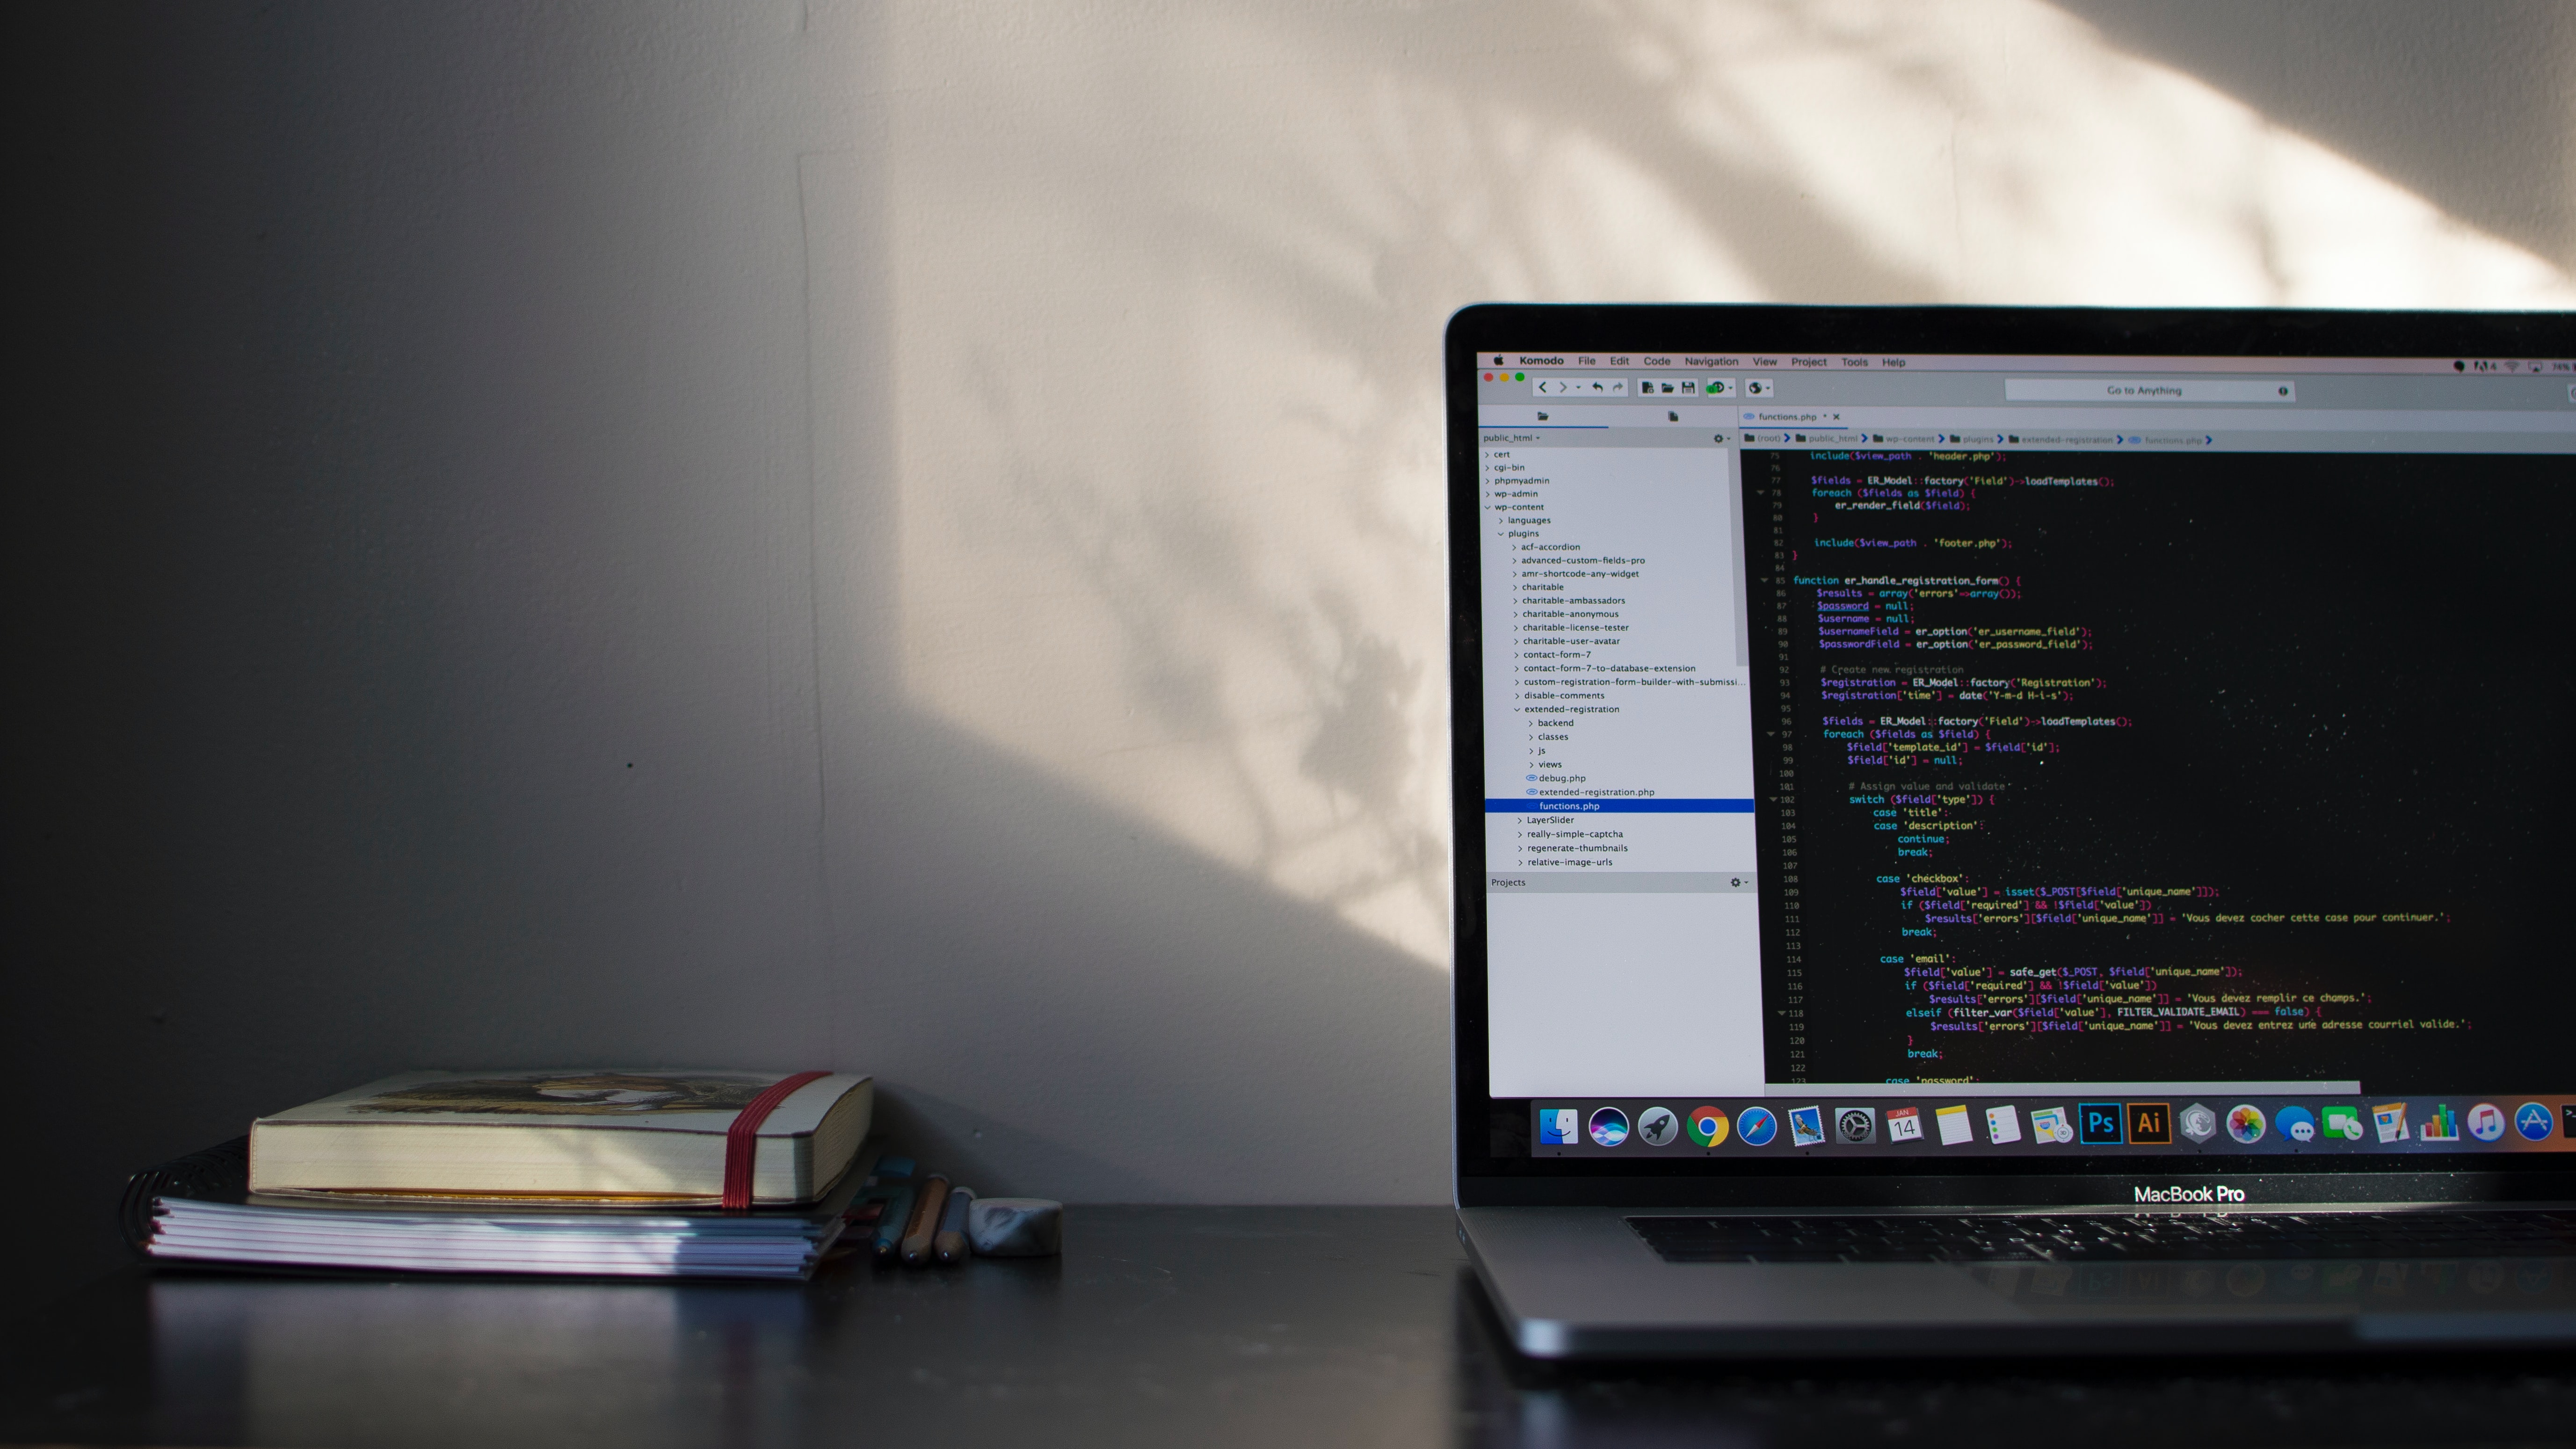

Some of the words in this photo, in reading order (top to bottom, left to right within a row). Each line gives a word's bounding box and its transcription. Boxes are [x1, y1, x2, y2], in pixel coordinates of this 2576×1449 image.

[1520, 356, 1564, 365] Komodo
[1578, 356, 1596, 365] File
[1610, 356, 1629, 366] Edit
[1644, 356, 1671, 366] Code
[1685, 357, 1739, 368] Navigation
[1753, 357, 1778, 366] View
[1792, 357, 1827, 368] Project
[1842, 358, 1868, 367] Tools
[1882, 358, 1906, 368] Help
[2138, 387, 2182, 396] Anything
[1759, 413, 1817, 422] functions.php
[1484, 434, 1532, 443] public_html
[1809, 435, 1858, 443] public_html
[1963, 436, 1994, 445] plugins
[2022, 436, 2114, 445] extended-registration
[2145, 437, 2203, 445] functions.php
[1810, 451, 1912, 462] include($view_path
[1929, 451, 2006, 462] 'header.php');
[1494, 464, 1525, 473] cgi-bin
[1495, 477, 1550, 485] phpmyadmin
[1811, 476, 1851, 485] $fields
[1494, 490, 1538, 499] wp-admin
[1812, 487, 1852, 498] foreach
[1857, 488, 1903, 498] ($fields
[1924, 488, 1965, 499] $field)
[1508, 516, 1551, 526] languages
[1509, 529, 1539, 539] plugins
[1521, 543, 1581, 551] acf-accordion
[1814, 538, 1917, 549] include($view_path
[1934, 538, 2012, 549] 'footer.php');
[1521, 556, 1646, 565] advanced-custom-fields-pro
[1522, 570, 1640, 579] amr-shortcode-any-widget
[1793, 575, 1840, 585] function
[1522, 583, 1564, 591] charitable
[1816, 588, 1863, 598] $results
[1817, 601, 1870, 612] $password
[1886, 601, 1914, 612] null;
[1523, 610, 1619, 619] charitable-anonymous
[1818, 613, 1870, 623] $username
[1886, 614, 1915, 624] null;
[1818, 626, 1899, 637] $usernameField
[1819, 639, 1900, 650] $passwordField
[1524, 650, 1591, 659] contact-form-7
[1831, 665, 1866, 676] Create
[1895, 665, 1964, 676] registration
[1524, 678, 1747, 687] custom-registration-form-builder-with-submissi...
[1821, 677, 1896, 689] $registration
[1959, 690, 2023, 701] date('Y-m-d
[2027, 690, 2073, 701] H-i-s');
[1524, 705, 1619, 715] extended-registration
[1822, 716, 1864, 726] $fields
[1538, 732, 1568, 741] classes
[1823, 729, 1865, 739] foreach
[1870, 729, 1916, 740] ($fields
[1938, 729, 1980, 740] $field)
[1538, 746, 1546, 756] js
[1985, 742, 2060, 753] $field['id'];
[1847, 755, 1917, 766] $field['id']
[1934, 755, 1963, 766] null;
[1539, 774, 1586, 784] debug.php
[1539, 788, 1655, 797] extended-registration.php
[1850, 793, 1885, 804] switch
[1890, 794, 1983, 806] ($field['type'])
[1540, 802, 1600, 811] functions.php
[1873, 809, 1897, 818] case
[1903, 807, 1948, 817] 'title':
[1527, 816, 1575, 826] LayerSlider
[1904, 820, 1983, 832] 'description':
[1527, 830, 1624, 839] really-simple-captcha
[1897, 833, 1950, 845] continue;
[1528, 844, 1628, 854] regenerate-thumbnails
[1898, 847, 1933, 858] break;
[1528, 858, 1613, 868] relative-image-urls
[1492, 878, 1526, 888] Projects
[1907, 873, 1969, 883] 'checkbox':
[1900, 886, 1988, 898] $field['value']
[1901, 900, 1913, 910] if
[2054, 899, 2152, 911] !$field['value'])
[2182, 913, 2211, 922] 'Vous
[2215, 913, 2245, 922] devez
[2250, 913, 2286, 922] cocher
[2290, 913, 2320, 922] cette
[2353, 914, 2377, 923] pour
[2382, 912, 2451, 923] continuer.';
[1902, 927, 1937, 938] break;
[1910, 953, 1956, 964] 'email':
[1904, 965, 1993, 978] $field['value']
[2010, 966, 2104, 978] safe_get($_POST,
[1905, 980, 1917, 990] if
[2059, 980, 2157, 992] !$field['value'])
[2187, 993, 2217, 1003] 'Vous
[2221, 993, 2251, 1003] devez
[2256, 993, 2298, 1004] remplir
[2320, 992, 2372, 1004] champs.';
[1906, 1007, 1942, 1018] elseif
[2274, 1006, 2310, 1017] false)
[2189, 1020, 2219, 1030] 'Vous
[2223, 1020, 2253, 1030] devez
[2258, 1021, 2294, 1030] entrez
[2322, 1020, 2363, 1029] adresse
[2368, 1019, 2414, 1029] courriel
[2419, 1019, 2472, 1029] valide.';
[1908, 1049, 1943, 1060] break;
[1895, 1109, 1909, 1117] JAN
[1894, 1120, 1915, 1136] 14
[2089, 1112, 2114, 1133] Ps
[2138, 1112, 2160, 1133] Ai
[2134, 1186, 2214, 1202] MacBook
[2217, 1185, 2245, 1202] Pro
